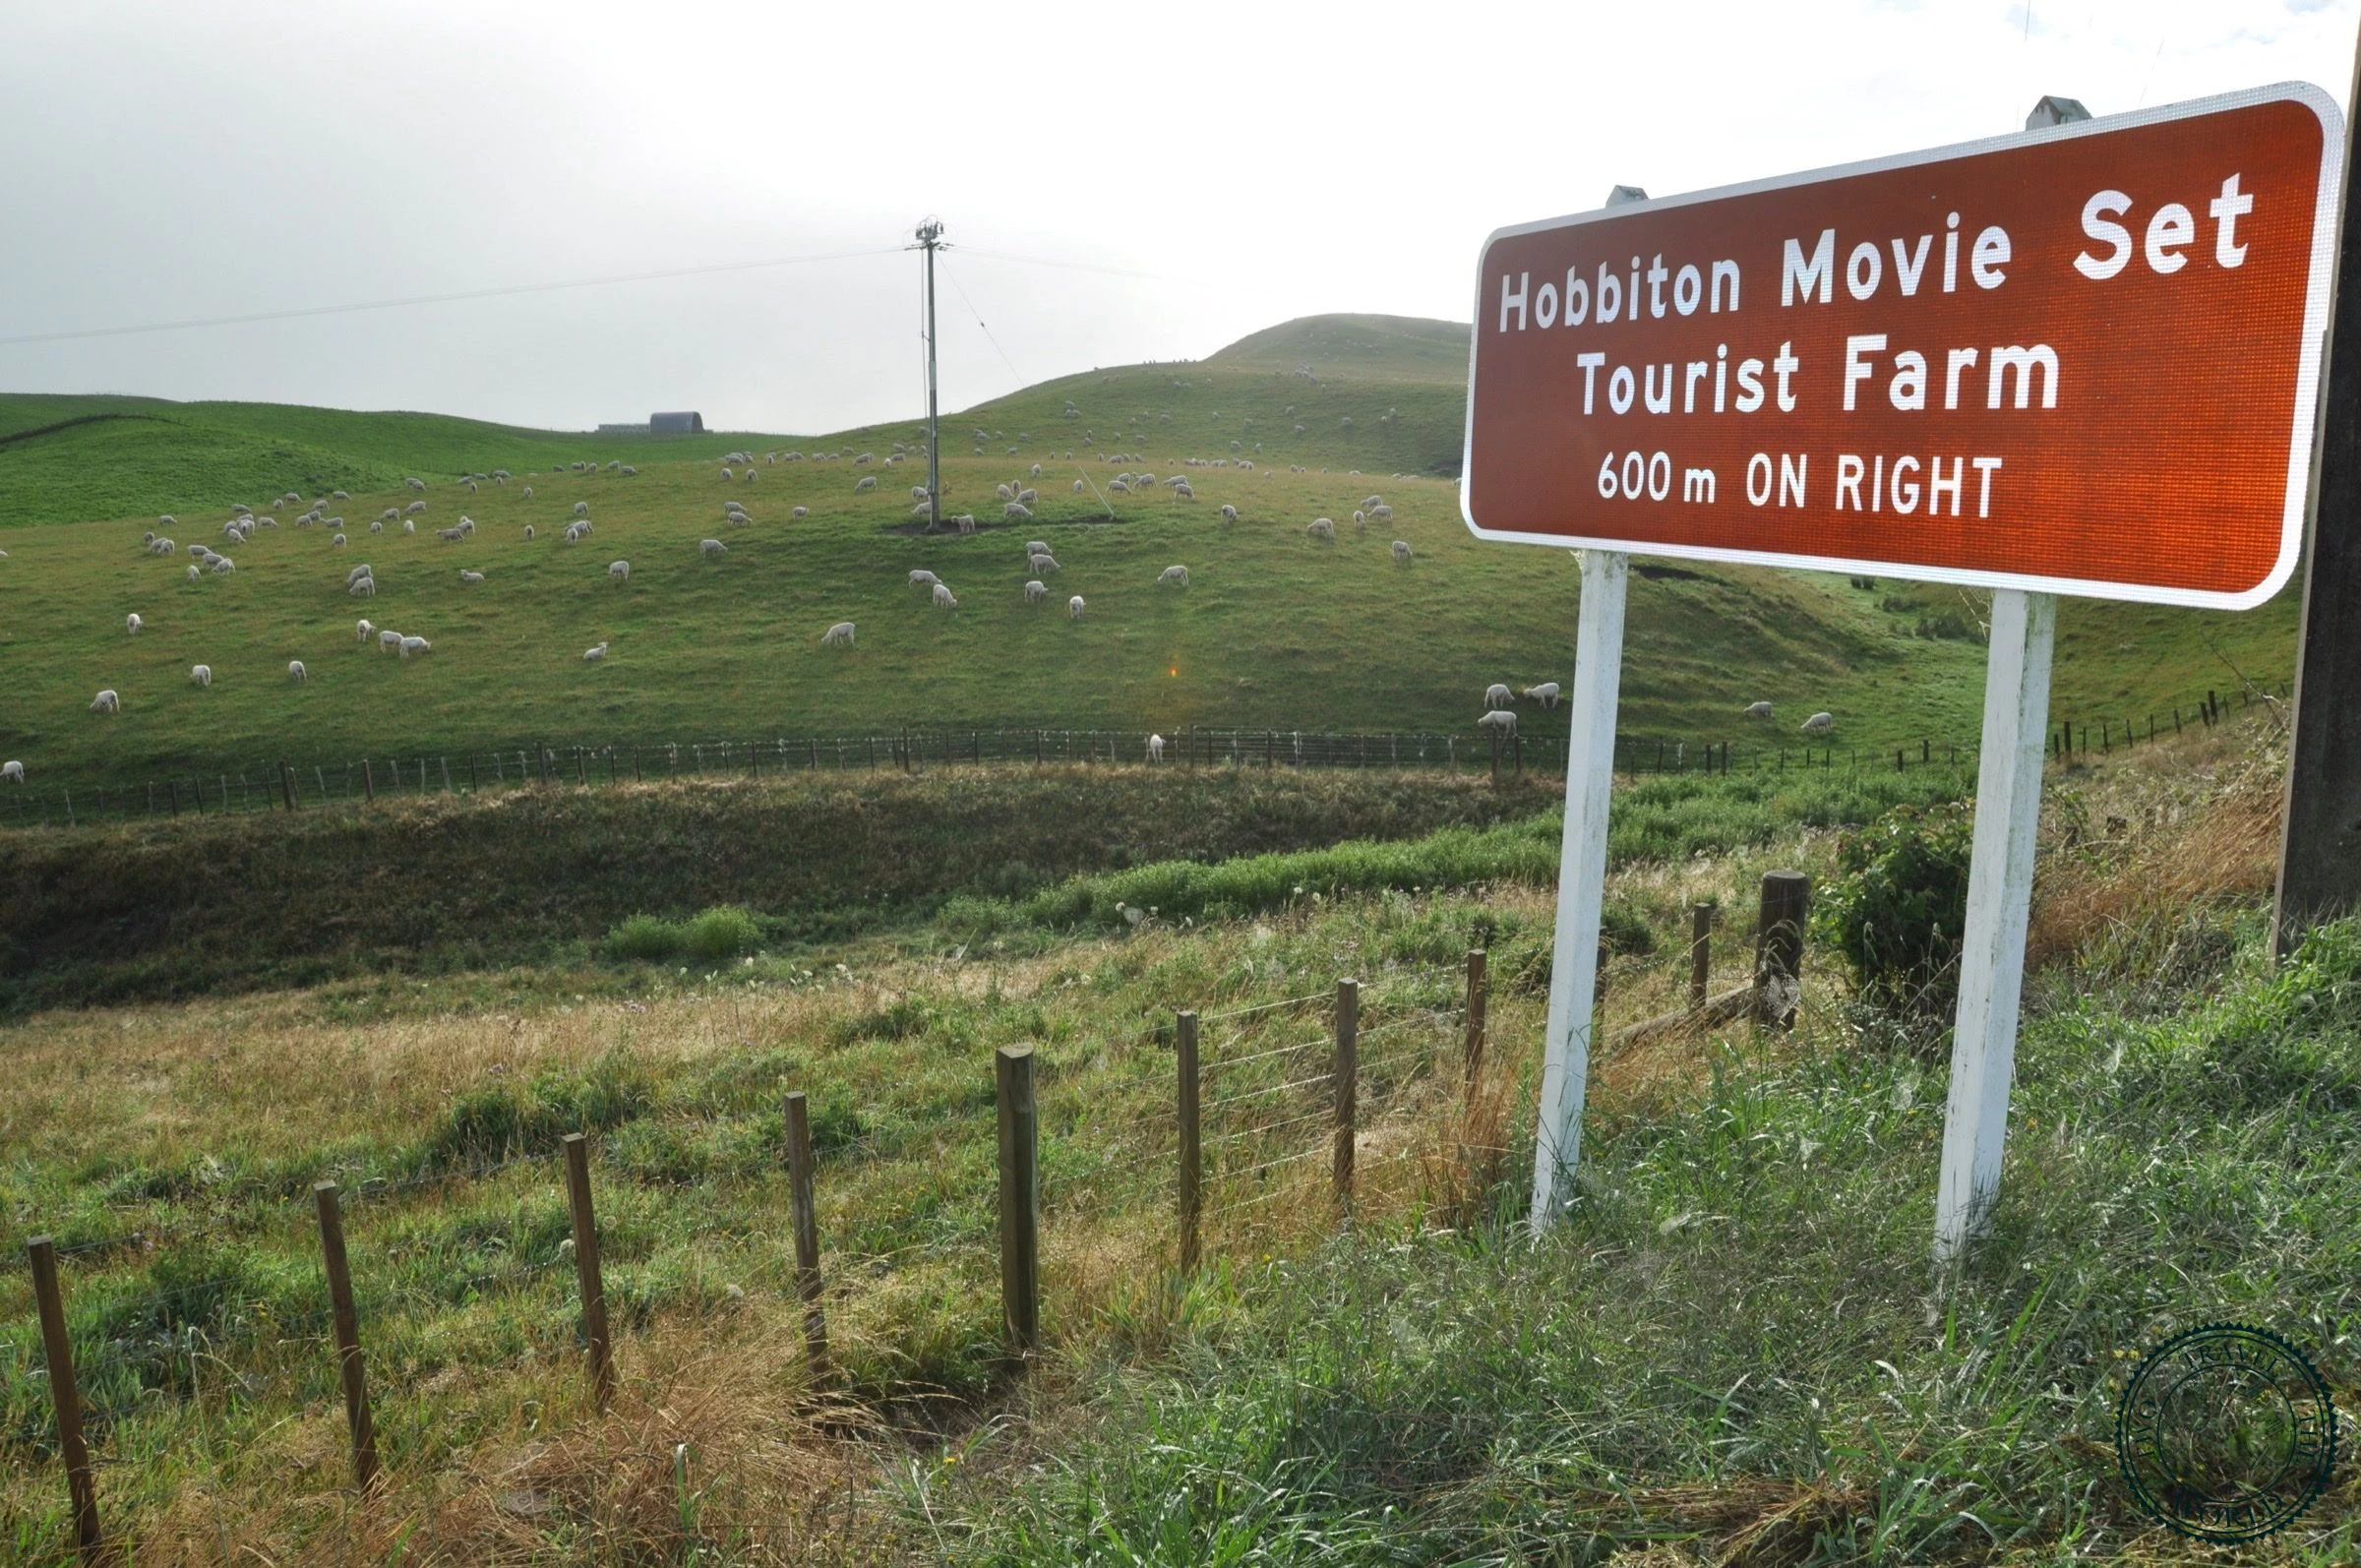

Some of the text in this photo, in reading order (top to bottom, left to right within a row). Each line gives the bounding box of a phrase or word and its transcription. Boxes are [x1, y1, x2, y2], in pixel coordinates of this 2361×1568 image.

[1500, 172, 2254, 332] Hobbiton Movie Set
[1577, 334, 2060, 415] Tourist Farm
[1598, 451, 2003, 518] 600 m ON RIGHT
